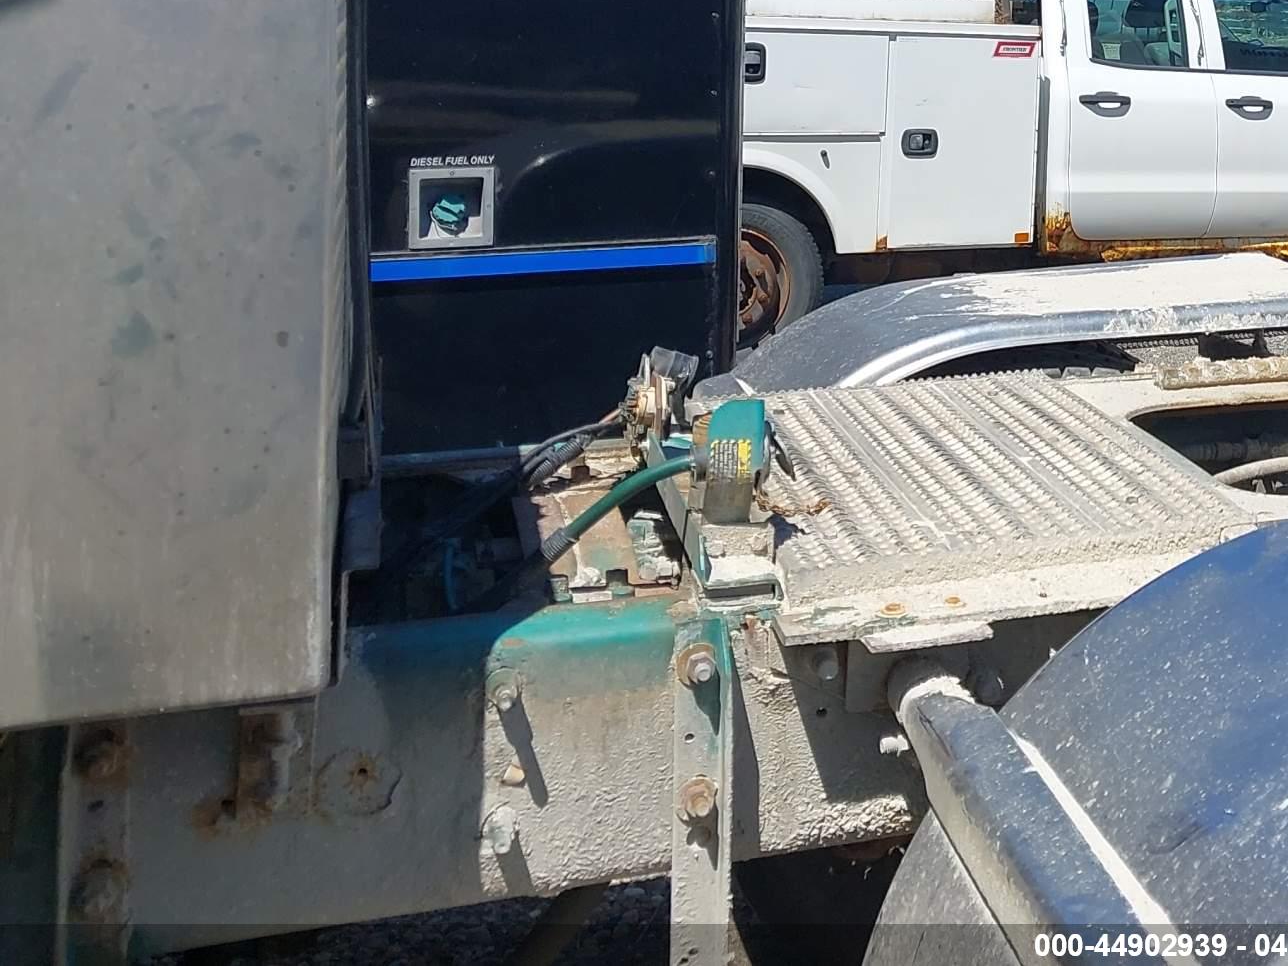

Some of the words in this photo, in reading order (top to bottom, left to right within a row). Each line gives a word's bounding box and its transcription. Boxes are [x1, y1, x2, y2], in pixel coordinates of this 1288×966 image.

[410, 157, 444, 167] DIESEL
[445, 156, 469, 166] FUEL
[470, 154, 495, 165] ONLY
